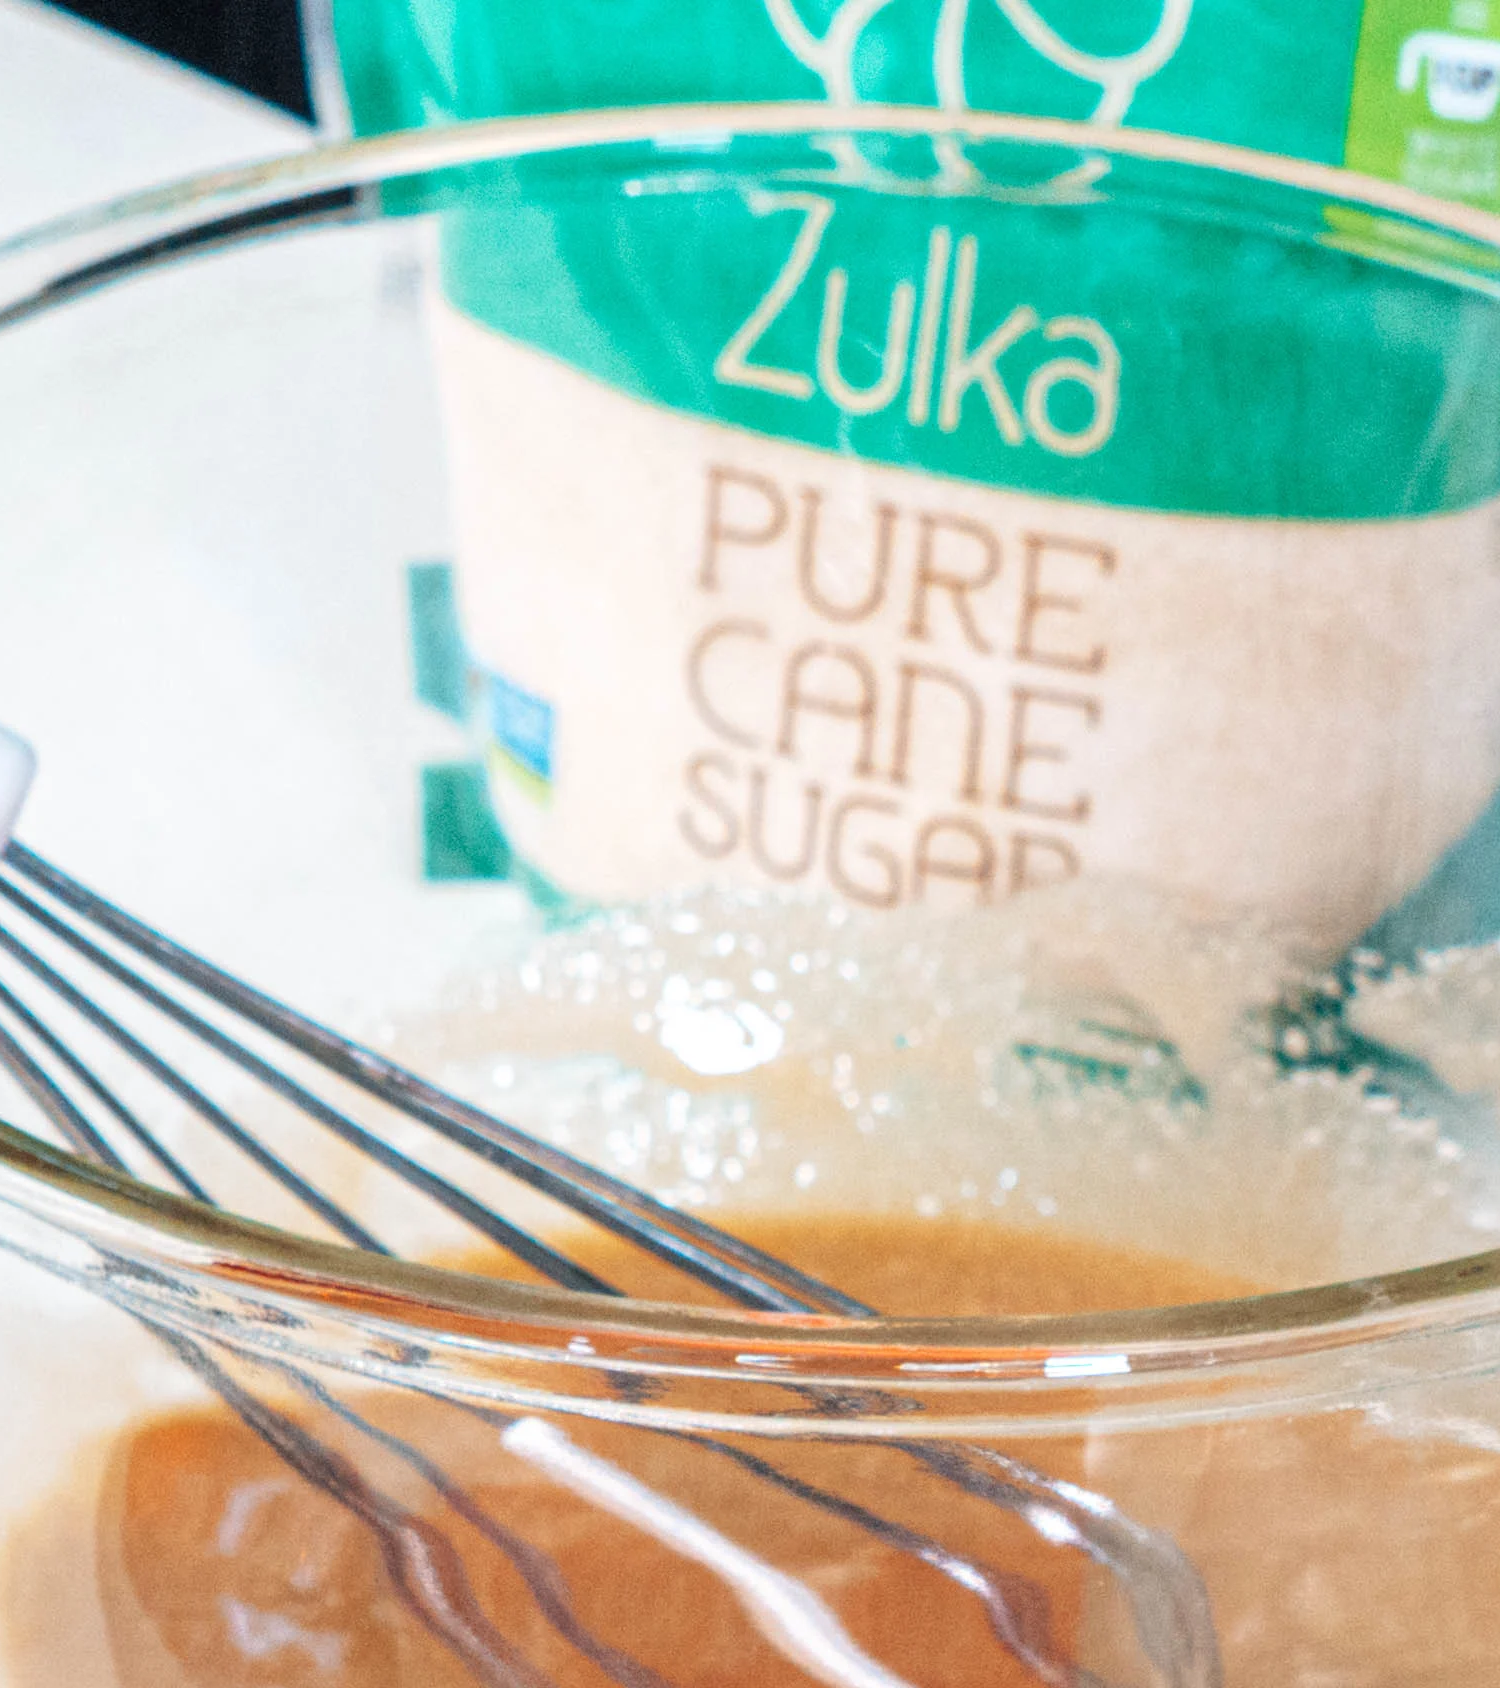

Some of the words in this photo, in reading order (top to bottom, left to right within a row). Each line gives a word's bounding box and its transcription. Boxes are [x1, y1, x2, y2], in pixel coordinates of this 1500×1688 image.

[714, 191, 1120, 457] Zulka
[699, 465, 1118, 675] PURE
[684, 619, 1102, 823] CANE
